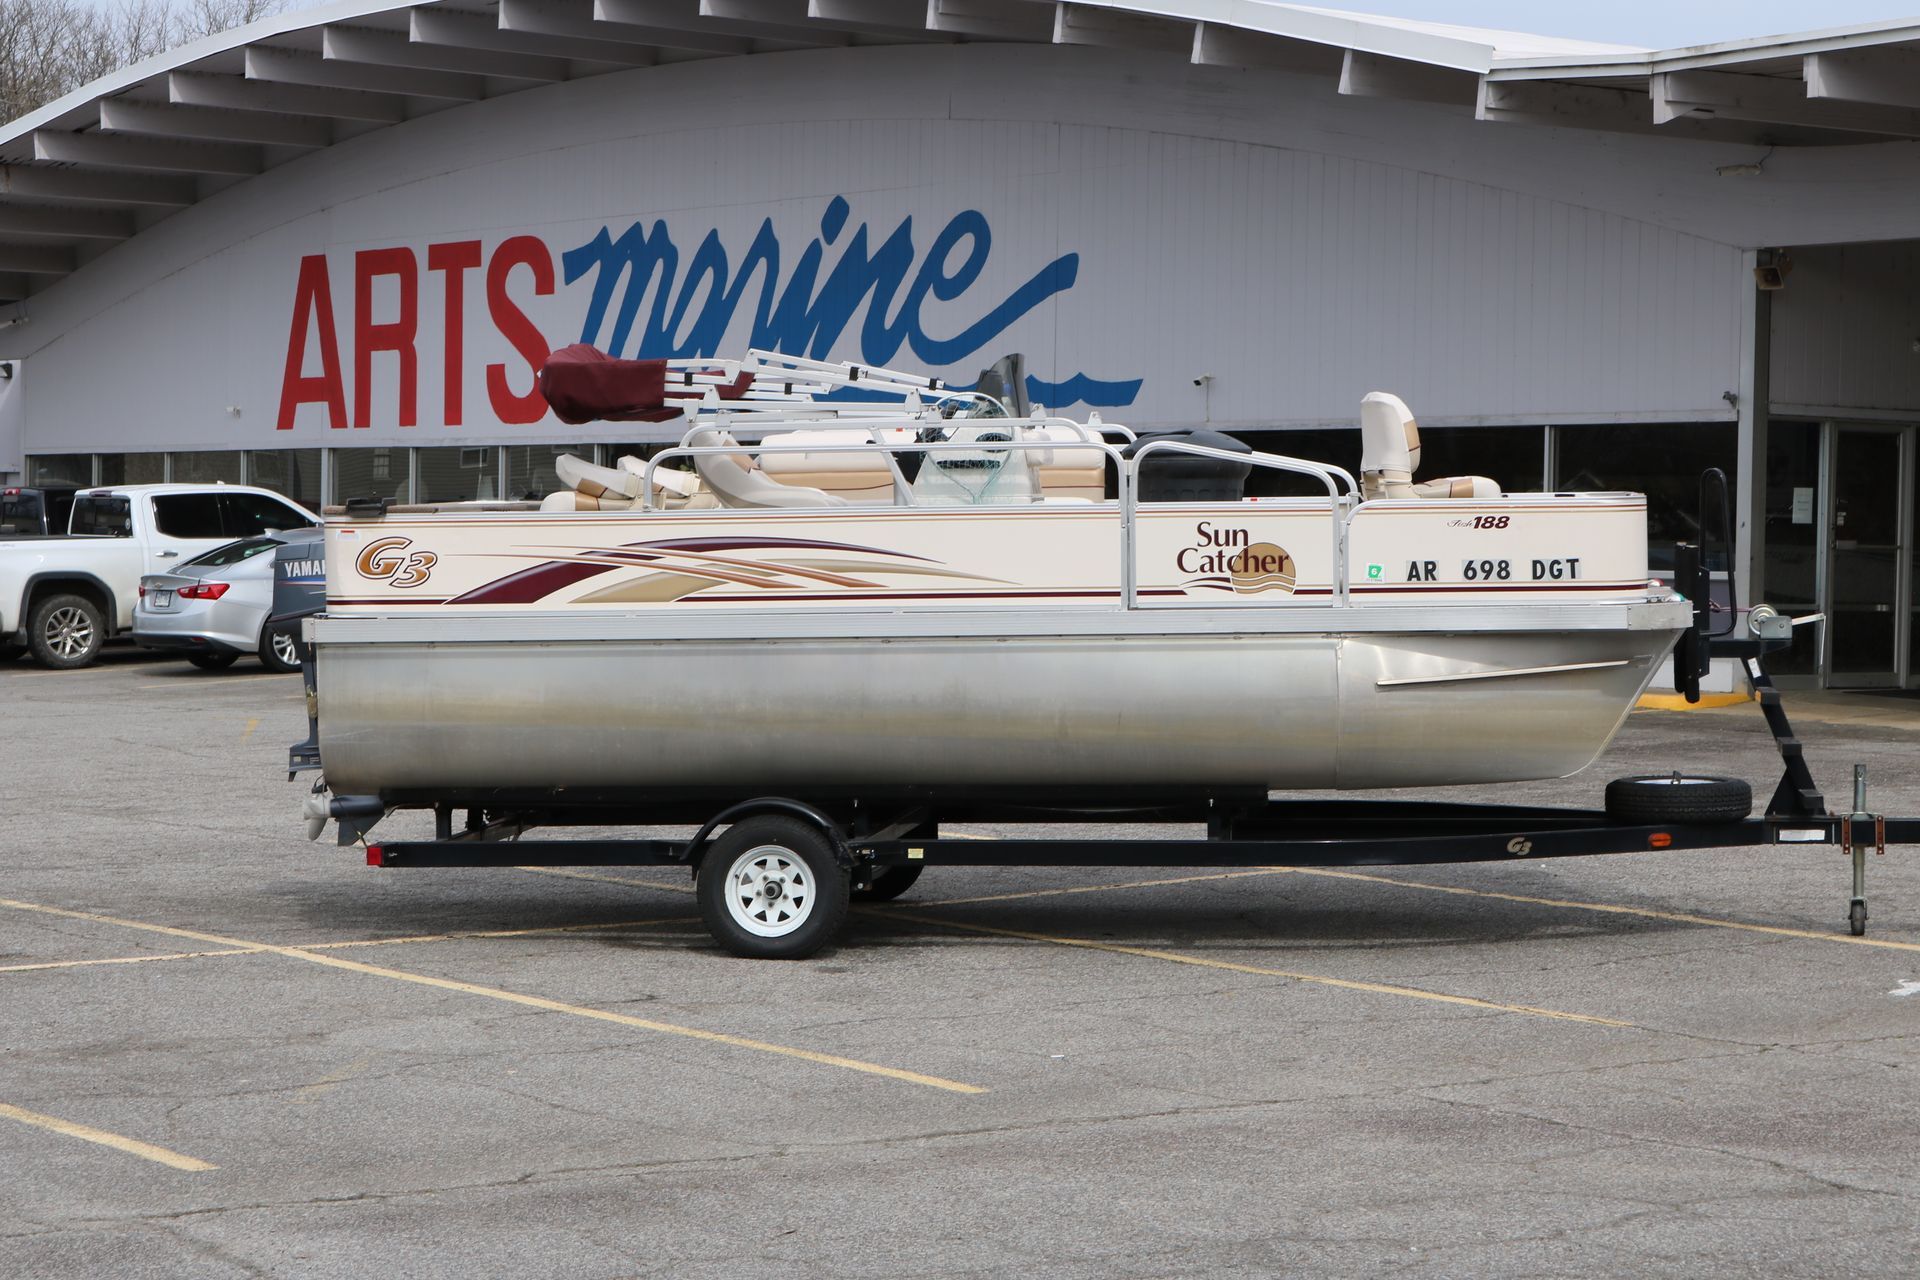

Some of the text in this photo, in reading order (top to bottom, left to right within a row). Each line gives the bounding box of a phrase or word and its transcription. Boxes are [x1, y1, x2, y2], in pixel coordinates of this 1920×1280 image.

[276, 235, 555, 431] ARTS
[1196, 521, 1249, 547] Sun
[1473, 515, 1510, 529] 188
[355, 536, 438, 588] G3
[1176, 547, 1290, 573] Catcher
[1407, 558, 1579, 581] AR 698 DGT
